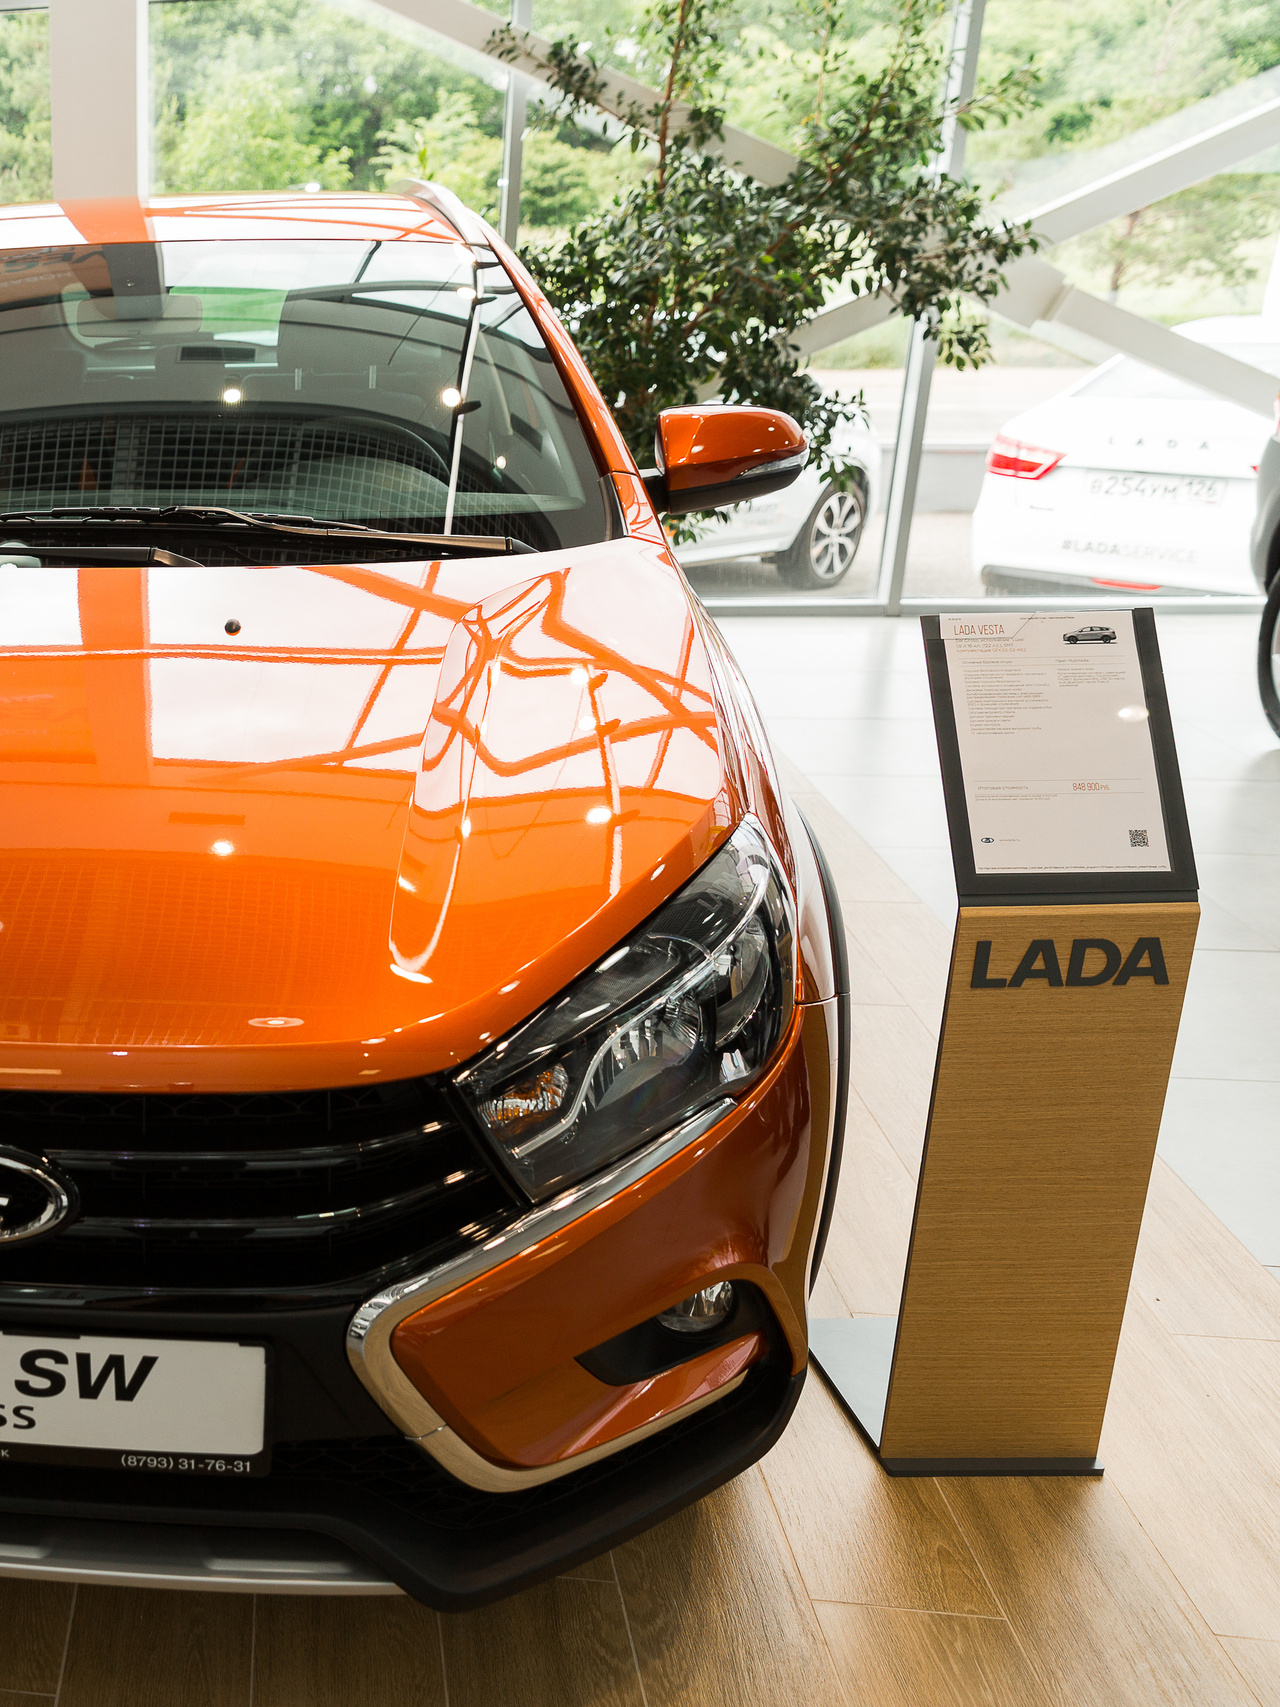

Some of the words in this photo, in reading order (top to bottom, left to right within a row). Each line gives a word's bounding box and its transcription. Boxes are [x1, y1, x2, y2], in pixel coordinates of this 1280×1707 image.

[1108, 436, 1209, 450] LADA
[1185, 478, 1217, 498] 126
[954, 624, 976, 636] LADA
[977, 624, 1005, 635] VESTA
[1072, 782, 1086, 791] 848
[1087, 782, 1100, 791] 900
[970, 937, 1169, 988] LADA
[14, 1349, 159, 1401] SW
[121, 1454, 174, 1470] (8793)
[178, 1458, 251, 1473] 31-76-31
